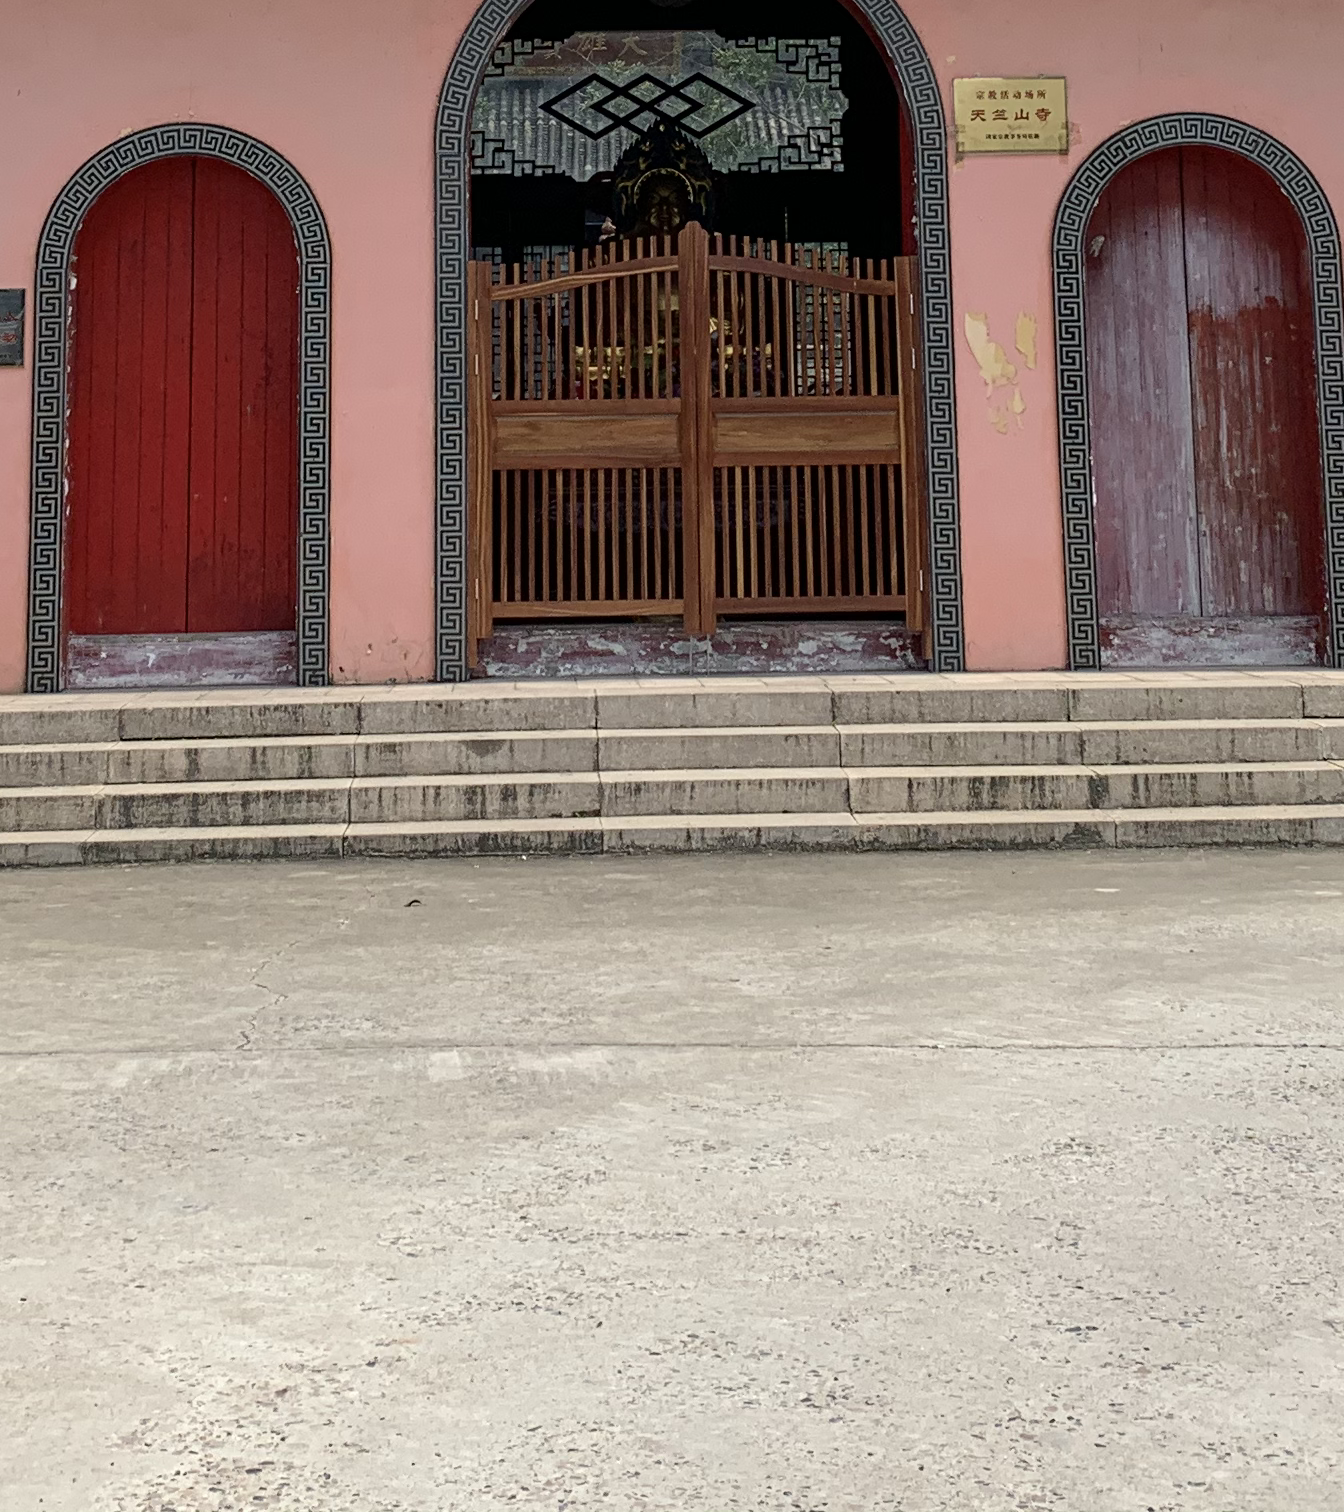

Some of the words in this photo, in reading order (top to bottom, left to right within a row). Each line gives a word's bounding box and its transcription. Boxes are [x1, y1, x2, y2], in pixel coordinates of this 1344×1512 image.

[975, 89, 1047, 100] 宗教活动场所
[970, 108, 1052, 122] 天竺山寺
